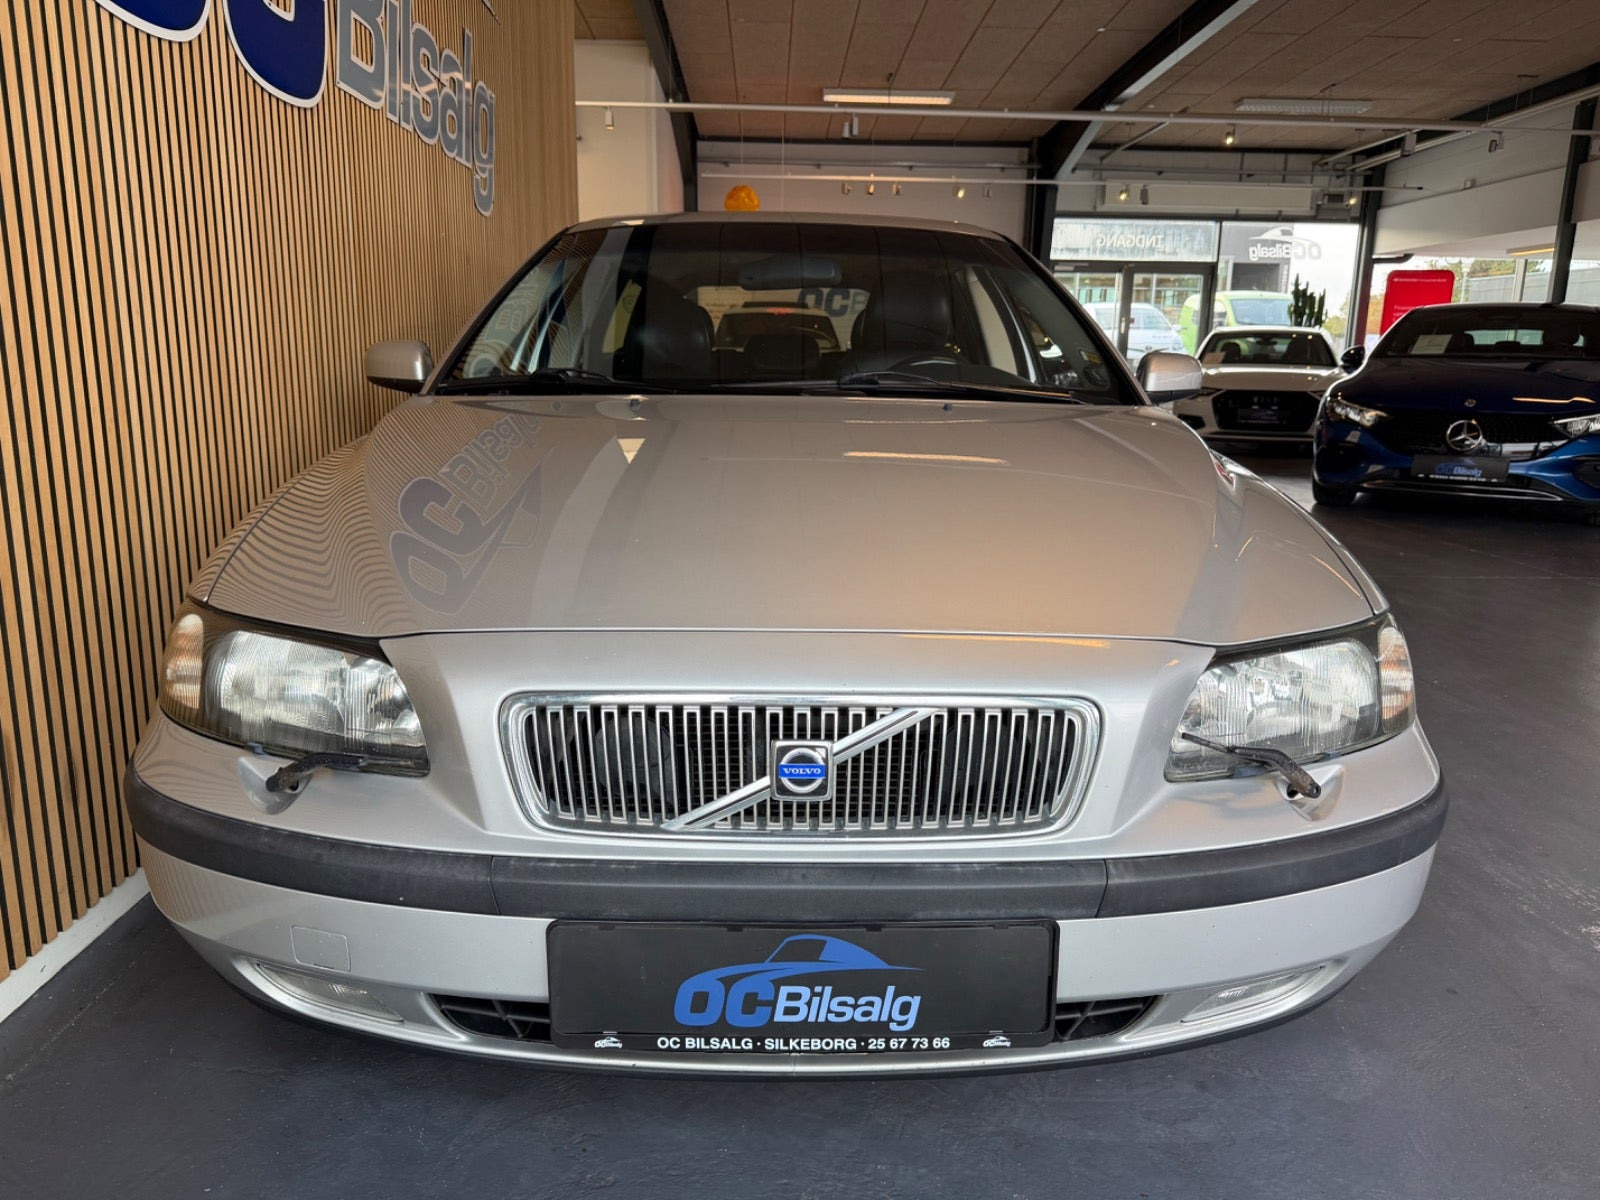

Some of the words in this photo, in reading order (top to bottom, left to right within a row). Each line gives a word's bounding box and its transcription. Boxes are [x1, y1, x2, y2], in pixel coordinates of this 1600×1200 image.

[782, 767, 822, 775] VOLVO
[657, 1036, 681, 1049] OC
[685, 1036, 753, 1050] BILSALG
[764, 1037, 857, 1050] SILKEBORG
[868, 1037, 886, 1049] 25
[889, 1037, 906, 1049] 67
[911, 1037, 929, 1049] 73
[932, 1037, 950, 1049] 66
